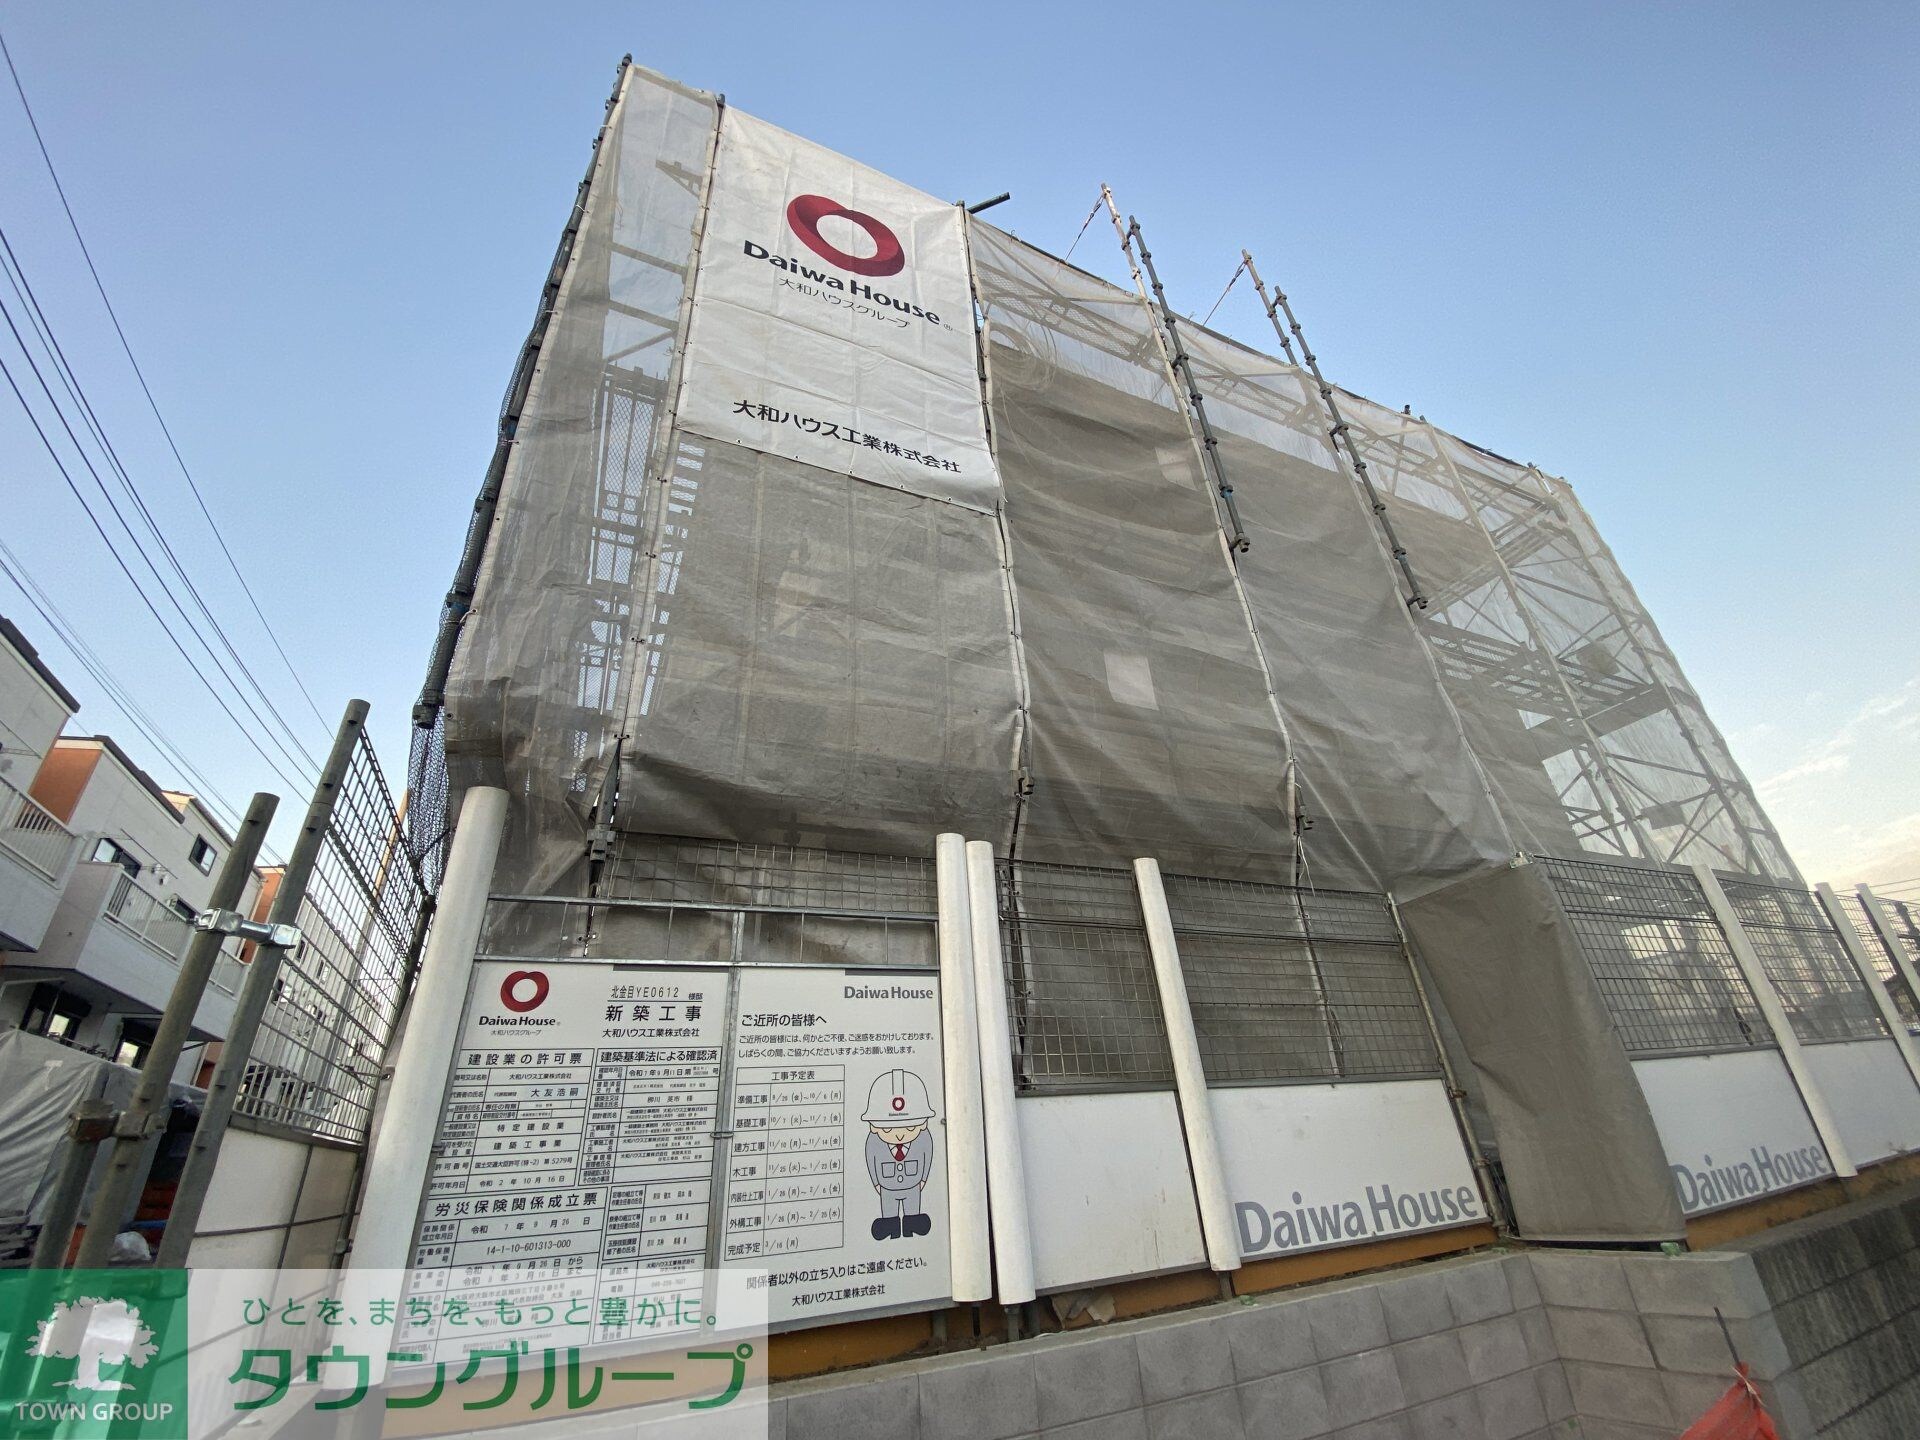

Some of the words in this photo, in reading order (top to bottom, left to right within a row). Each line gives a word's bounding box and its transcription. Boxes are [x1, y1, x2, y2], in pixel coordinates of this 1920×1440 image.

[743, 239, 845, 291] Daiwa
[850, 279, 941, 326] House
[780, 277, 910, 328] 大和ハウスグループ
[733, 400, 962, 474] 大和ハウス工業株式会社
[844, 985, 889, 999] Daiwa
[891, 985, 934, 999] House
[605, 1004, 702, 1021] 新築工事
[478, 1015, 517, 1026] Daiwa
[518, 1016, 556, 1026] House
[741, 1013, 827, 1027] ご近所の皆様へ
[602, 1027, 700, 1038] 大和ハウス工業株式会社
[467, 1052, 582, 1066] 建設業の許可票
[600, 1049, 717, 1063] 建築基準法による確認済
[509, 1072, 572, 1080] 大和ハウス工業株式会社
[771, 1070, 815, 1081] 工事予定表
[737, 1094, 768, 1104] 準備工事
[496, 1122, 565, 1132] 特定建設業
[735, 1117, 767, 1128] 基礎工事
[494, 1139, 562, 1150] 建築工事業
[734, 1141, 765, 1153] 建方工事
[733, 1166, 756, 1178] 木工事
[1669, 1154, 1760, 1211] Daiwa
[1751, 1145, 1828, 1188] House
[435, 1192, 598, 1217] 労災保険関係成立票
[730, 1216, 762, 1229] 外構工事
[1235, 1191, 1367, 1254] Daiwa
[1365, 1184, 1478, 1232] House
[728, 1242, 760, 1256] 完成予定
[746, 1257, 928, 1290] 関係者以外の立ち入りはご遠慮ください。
[792, 1284, 886, 1307] 大和ハウス工業株式会社
